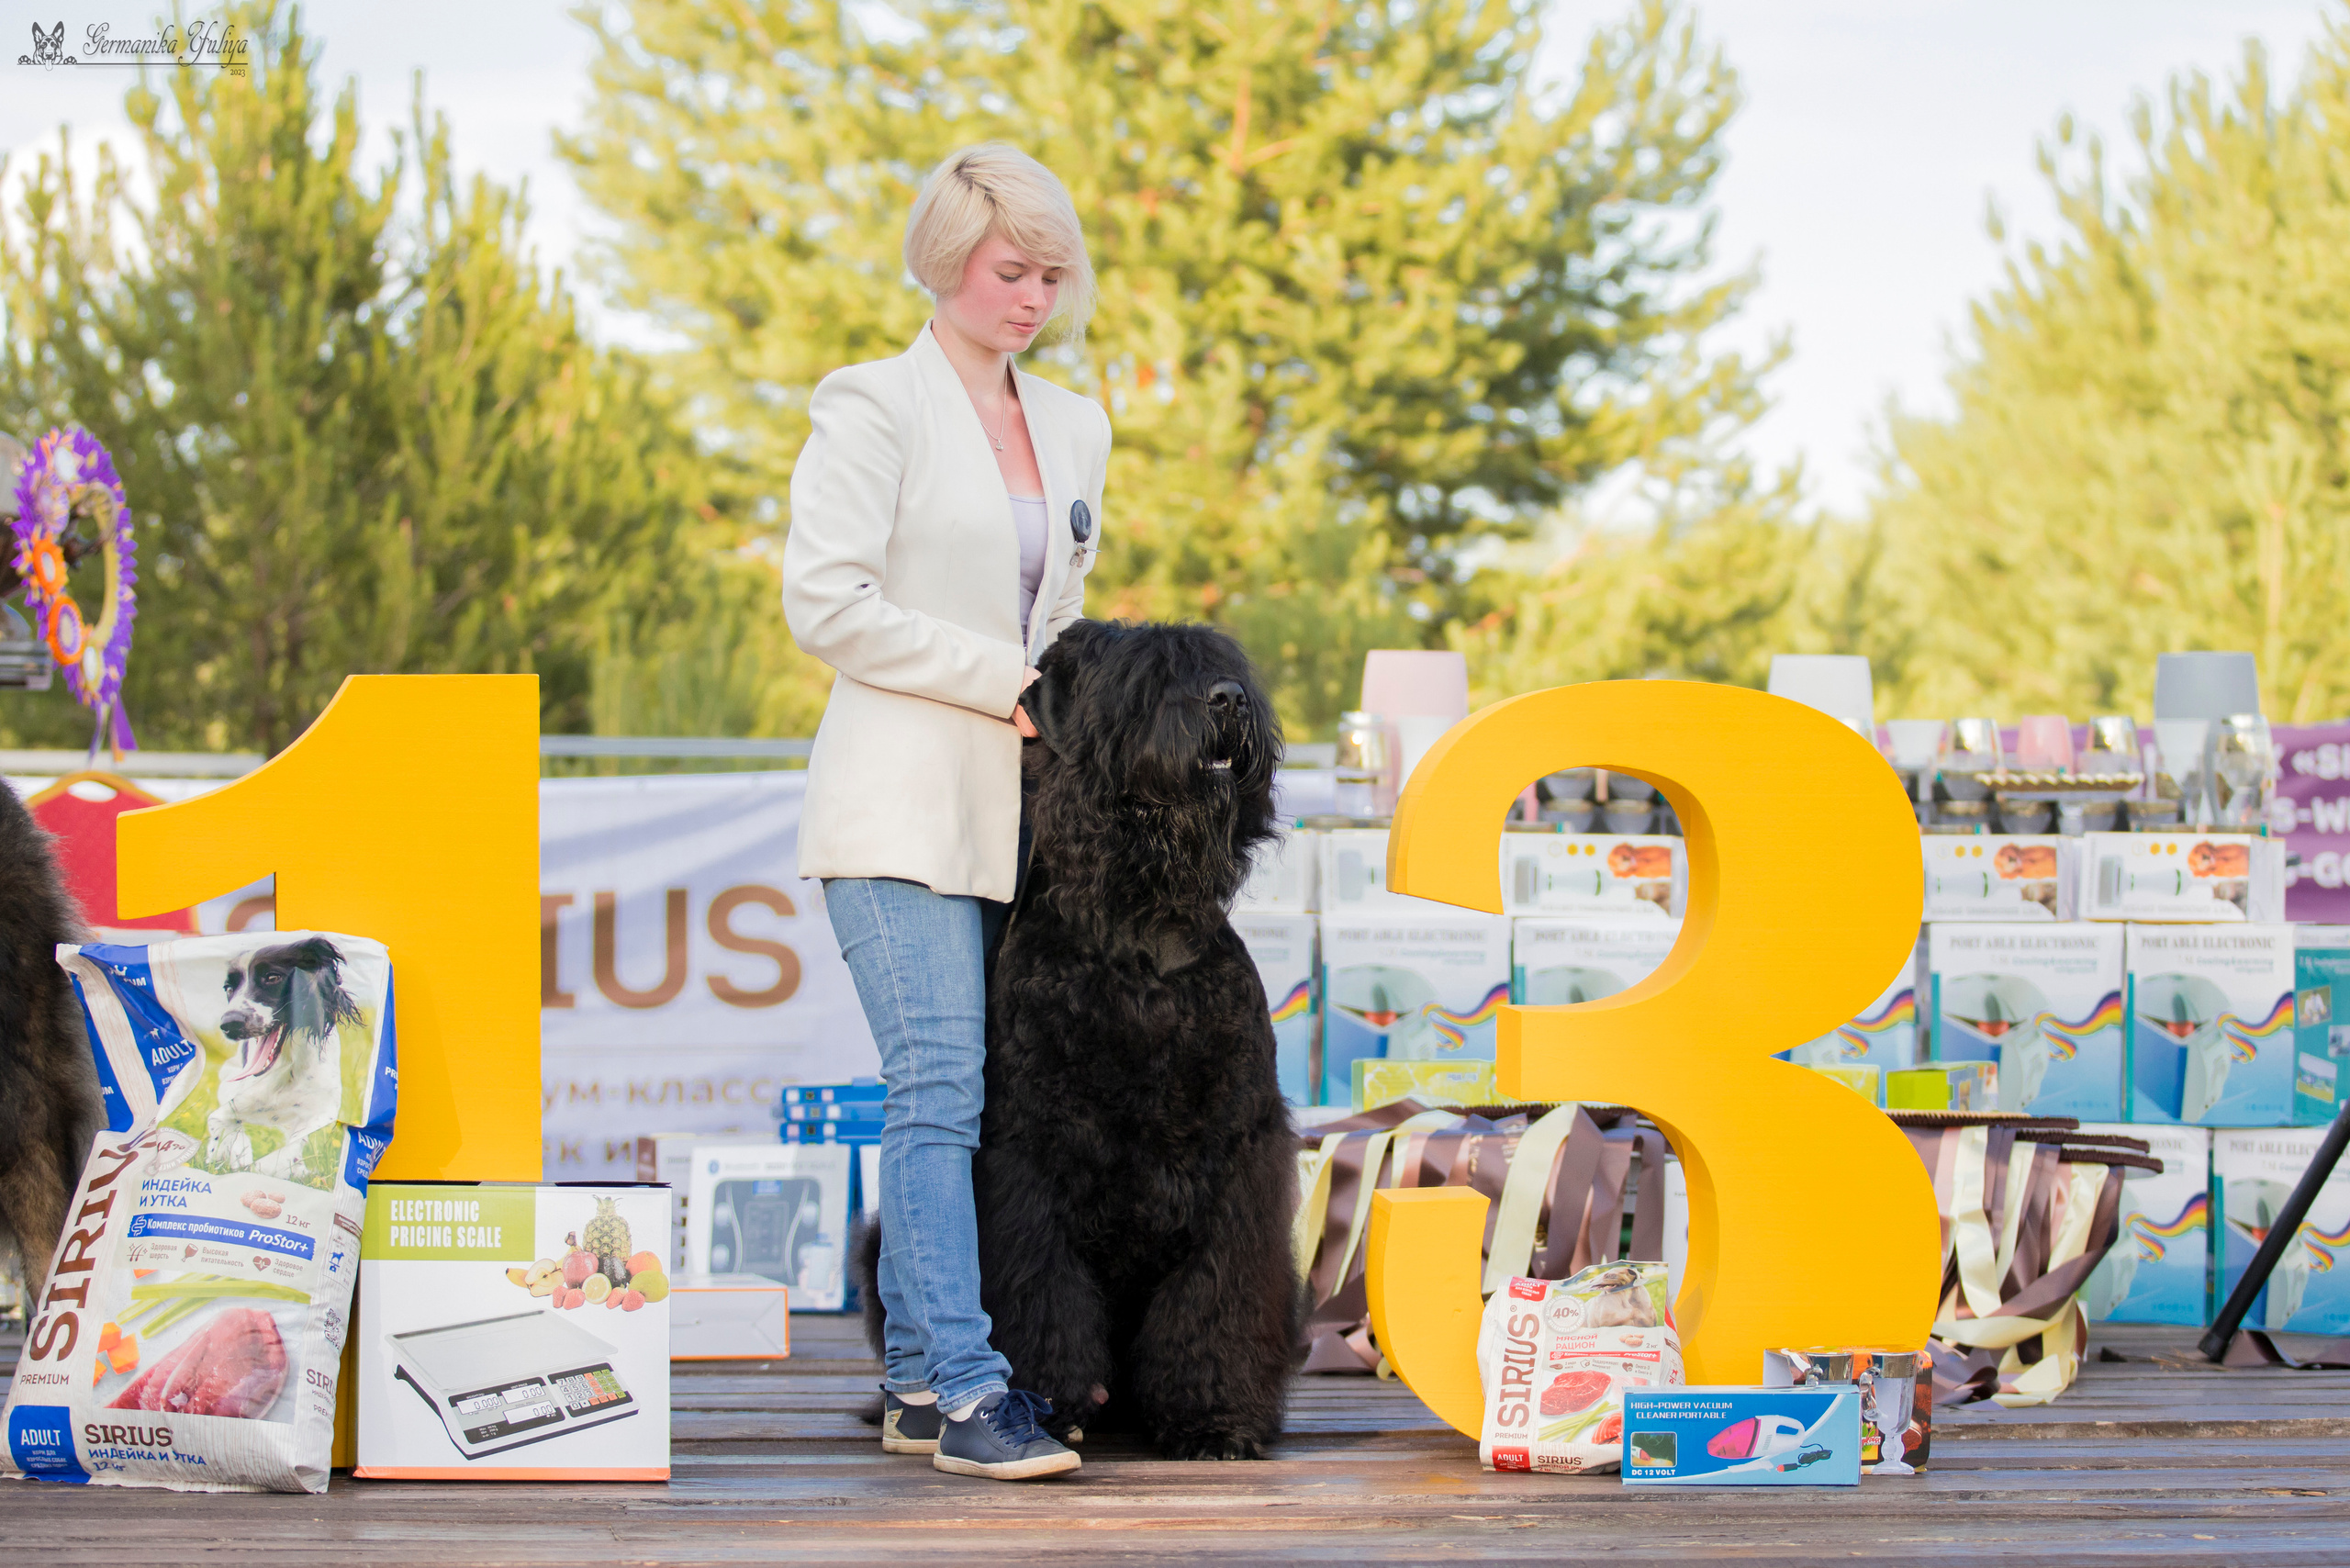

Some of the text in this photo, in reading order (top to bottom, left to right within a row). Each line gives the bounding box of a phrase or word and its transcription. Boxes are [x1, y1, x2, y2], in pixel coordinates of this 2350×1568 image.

[151, 1038, 194, 1067] ADULT
[1367, 679, 1942, 1444] 3
[141, 1178, 212, 1193] ИНДЕЙКА
[140, 1195, 187, 1208] И УТКА
[390, 1200, 479, 1222] ELECTRONIC
[285, 1215, 311, 1229] 12 кг
[147, 1218, 308, 1252] Комплекс пробиотиков ProStor+
[390, 1226, 501, 1248] PRICING SCALE
[202, 1247, 229, 1257] Высокая
[1552, 1307, 1579, 1318] 40%
[1556, 1341, 1595, 1350] РАЦИОН
[1497, 1314, 1540, 1428] SIRIUS
[19, 1374, 69, 1385] PREMIUM
[21, 1429, 61, 1446] ADULT
[85, 1424, 172, 1447] SIRIUS
[89, 1448, 207, 1466] ИНДЕЙКА И УТКА
[1538, 1455, 1582, 1465] SIRIUS
[94, 1462, 109, 1472] 12
